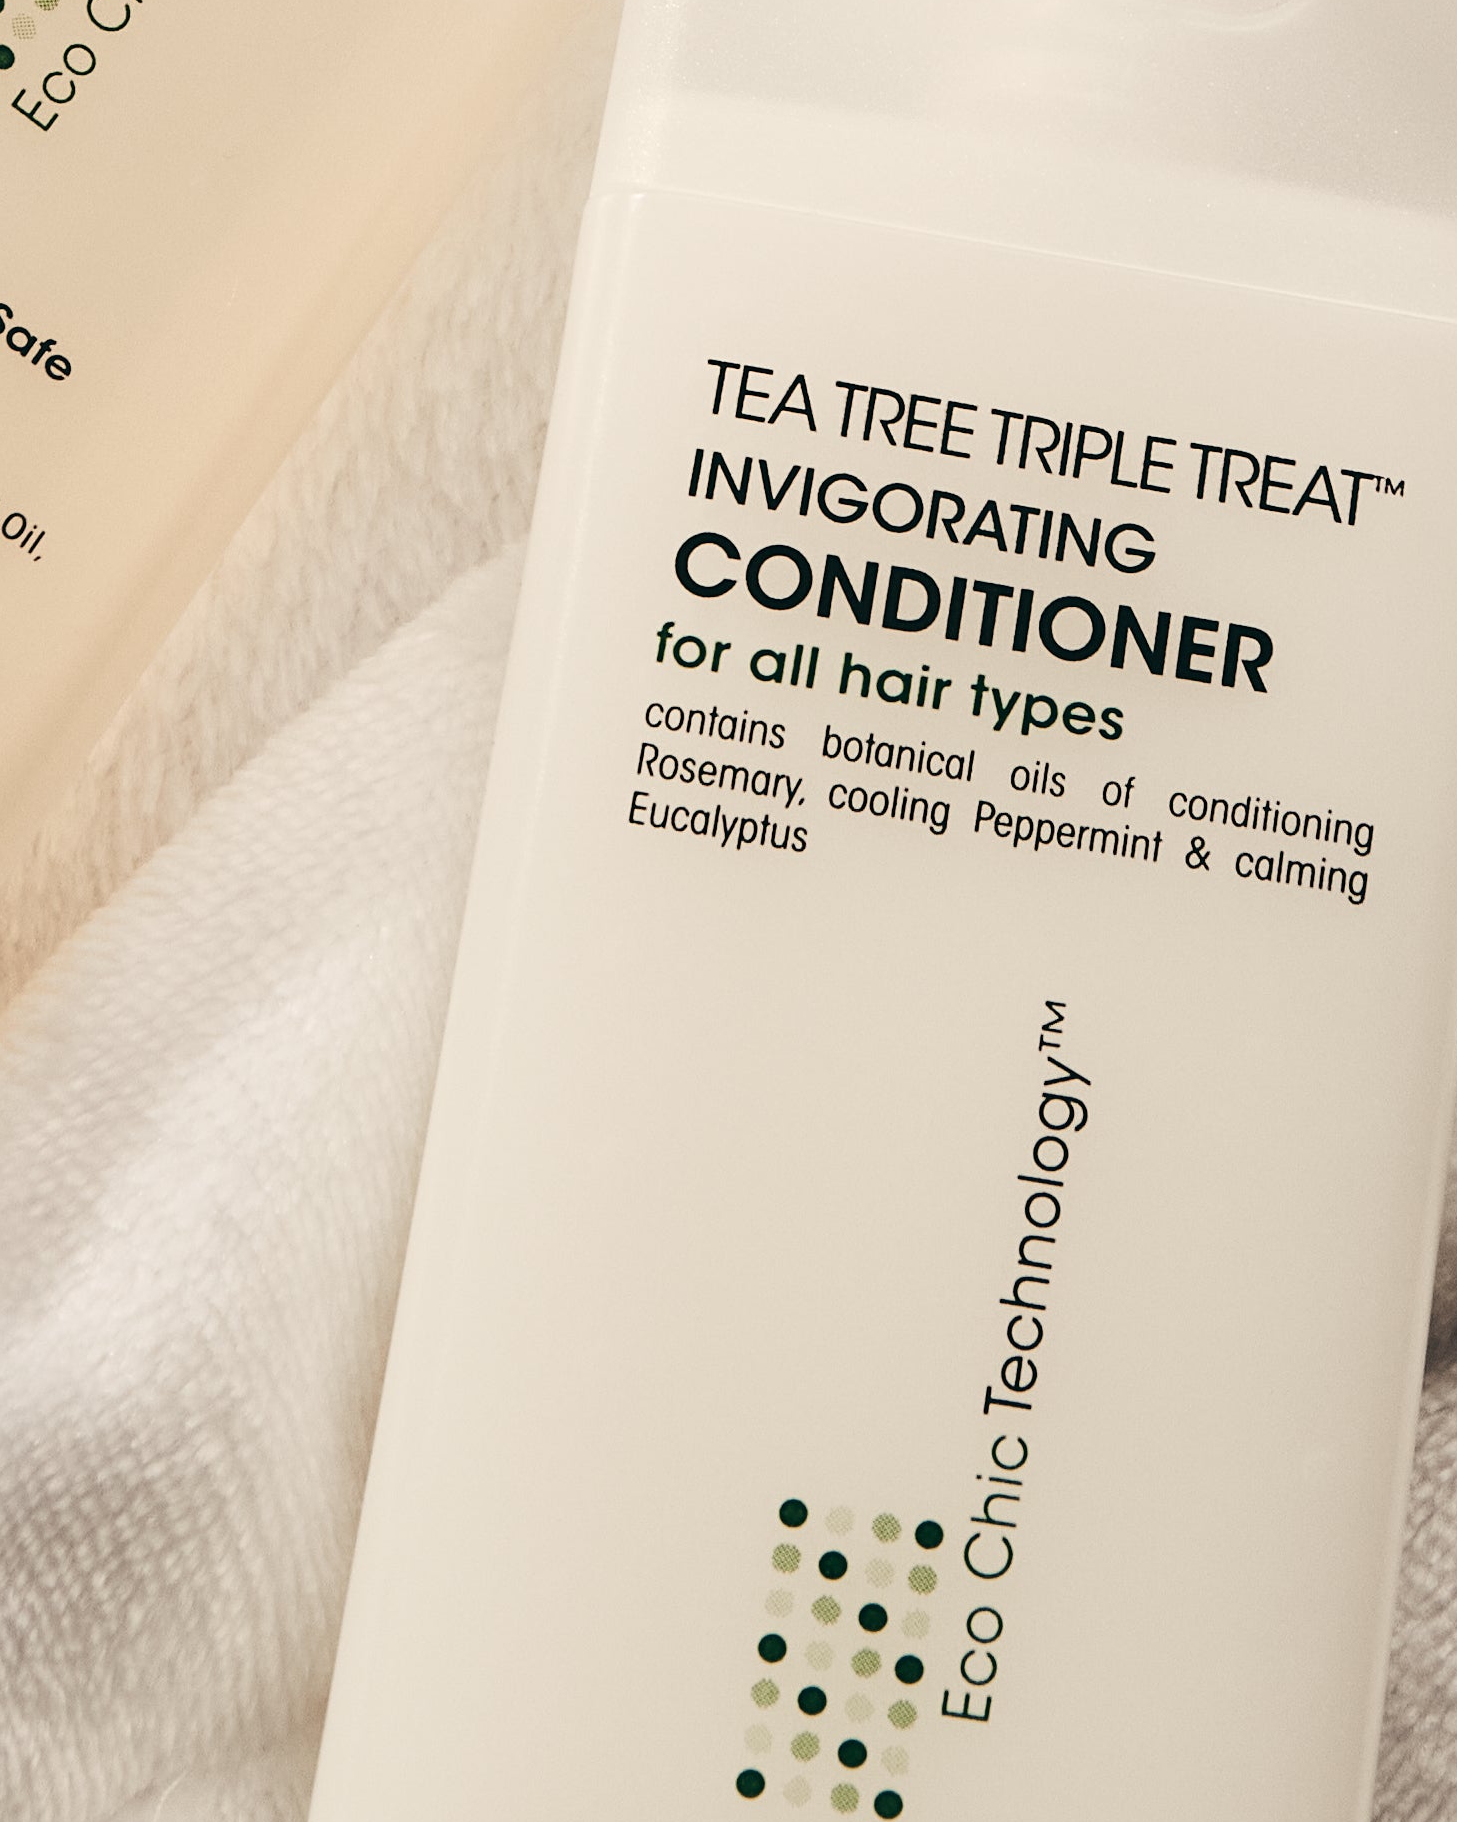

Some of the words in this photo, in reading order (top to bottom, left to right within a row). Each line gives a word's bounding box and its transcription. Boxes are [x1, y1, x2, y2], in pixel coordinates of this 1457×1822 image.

[10, 43, 97, 133] Eco
[707, 358, 818, 433] TEA
[834, 380, 979, 460] TREE
[990, 407, 1178, 495] TRIPLE
[0, 511, 46, 562] Oil,
[687, 447, 1157, 575] INVIGORATING
[674, 531, 1274, 694] CONDITIONER
[655, 620, 733, 674] for
[749, 643, 820, 690] all
[838, 651, 953, 711] hair
[969, 673, 1125, 741] types
[628, 790, 808, 853] Eucalyptus
[636, 741, 806, 810] Rosemary,
[828, 783, 951, 836] cooling
[973, 799, 1164, 864] Peppermint
[1184, 834, 1212, 872] &
[1234, 849, 1369, 906] calming
[644, 702, 786, 750] contains
[821, 723, 976, 783] botanical
[1010, 761, 1067, 798] oils
[1101, 775, 1137, 810] of
[1168, 791, 1375, 858] conditioning
[962, 1434, 1029, 1580] Chic
[940, 1605, 1004, 1723] Eco
